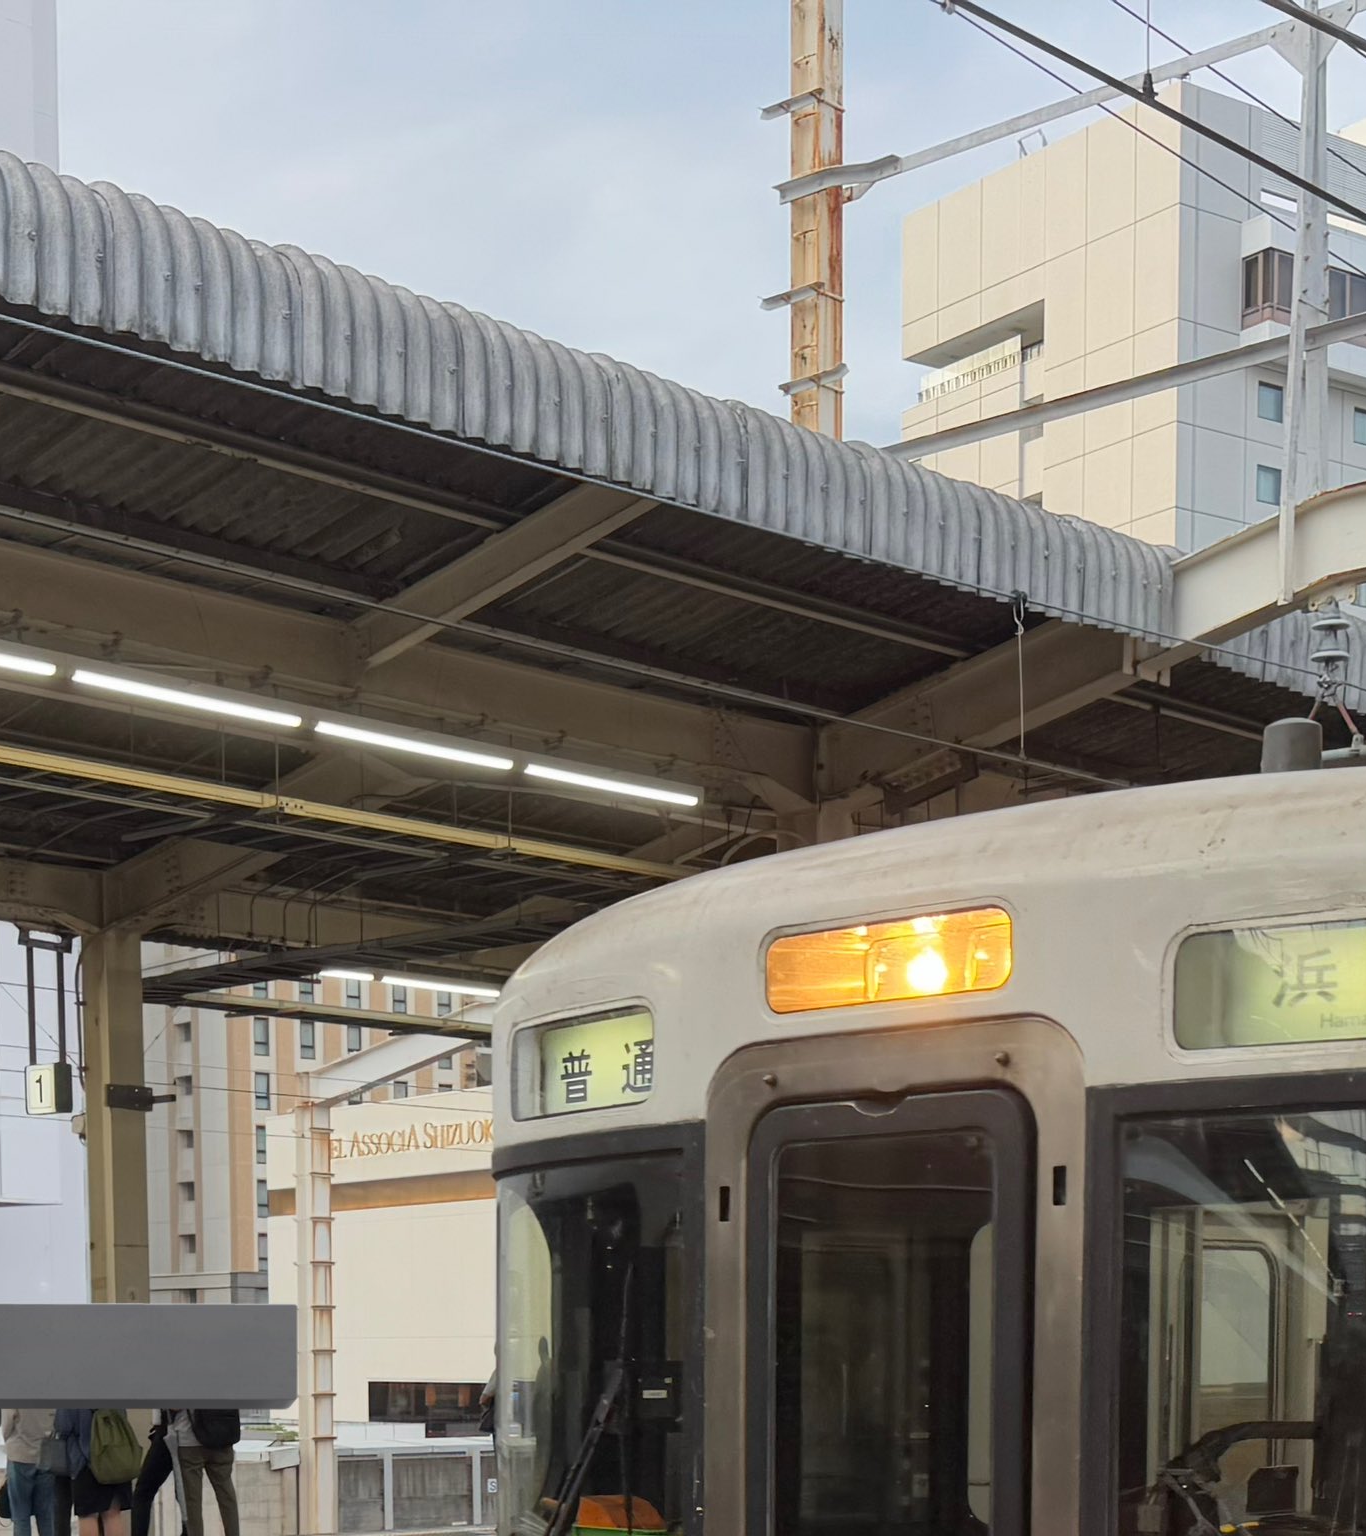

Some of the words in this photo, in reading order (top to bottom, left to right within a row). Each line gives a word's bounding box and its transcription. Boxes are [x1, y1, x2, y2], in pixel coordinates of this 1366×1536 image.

[561, 1038, 653, 1104] 普通
[35, 1074, 43, 1103] 1
[351, 1124, 420, 1157] ASSOCIA
